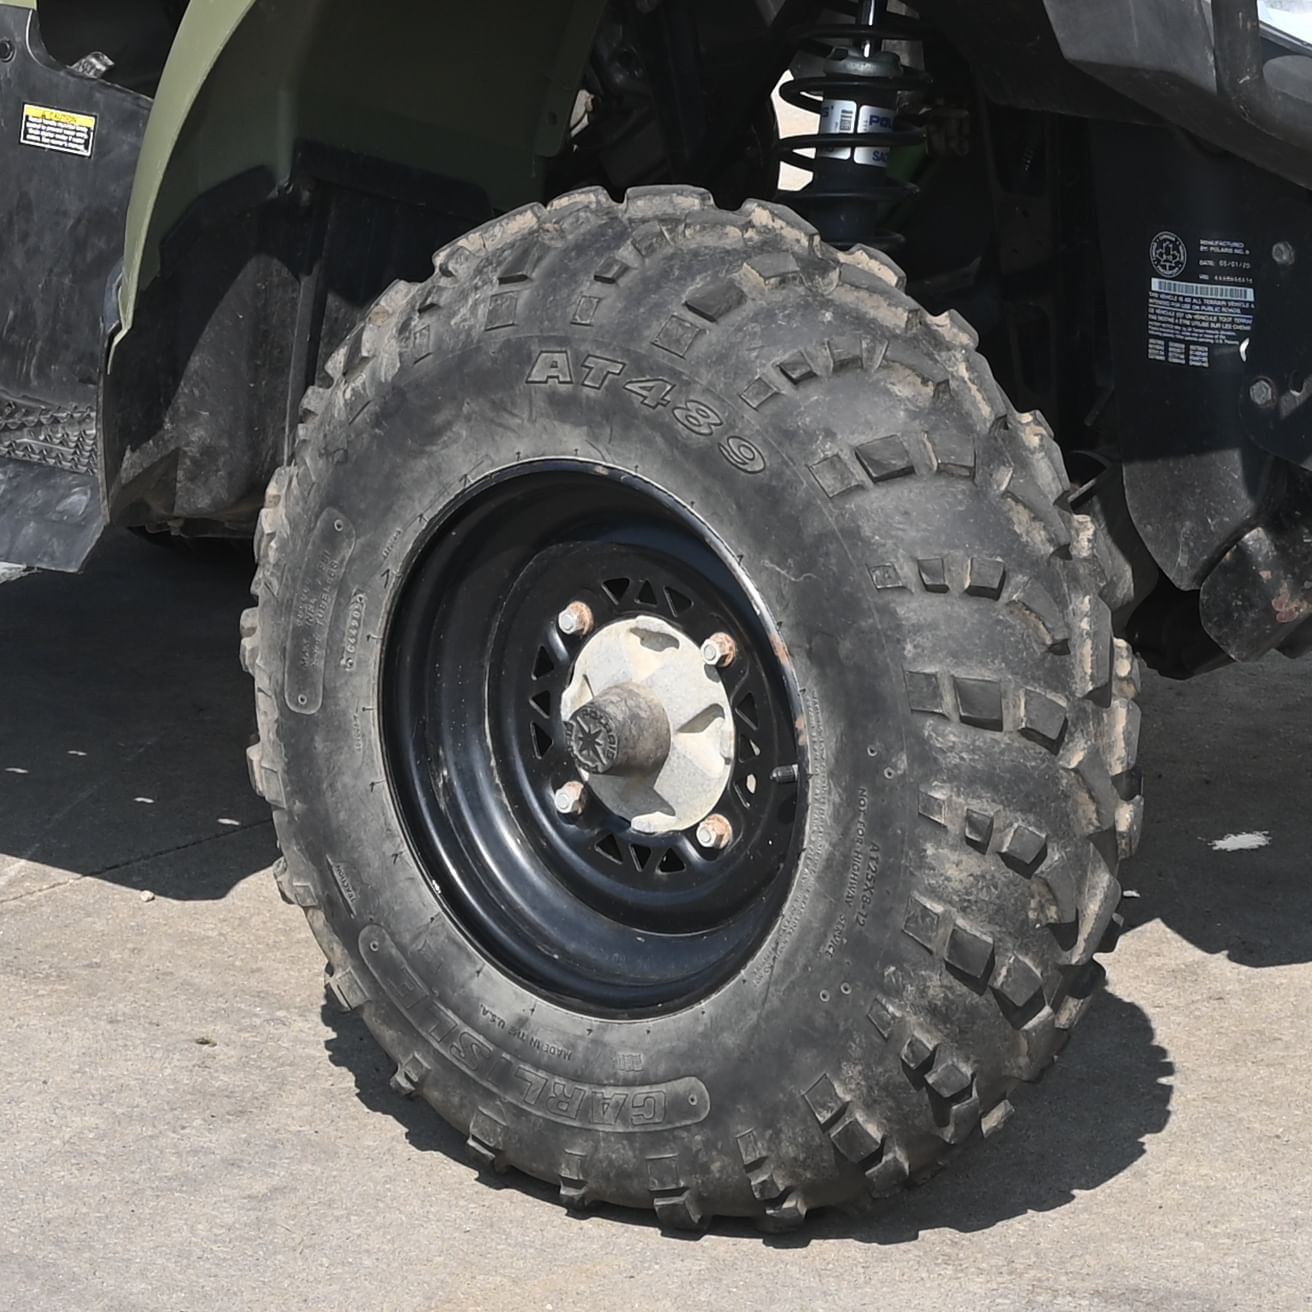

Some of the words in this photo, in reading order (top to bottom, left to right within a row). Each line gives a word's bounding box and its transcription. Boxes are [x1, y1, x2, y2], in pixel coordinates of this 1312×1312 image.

[525, 350, 766, 474] AT489
[857, 786, 868, 816] NOT
[855, 819, 866, 845] FOR
[845, 849, 864, 908] HIGHWAY
[856, 842, 881, 927] AT25X8-12
[824, 914, 848, 958] SERVICE
[391, 964, 668, 1126] CARLISLE
[540, 1039, 573, 1062] MADE
